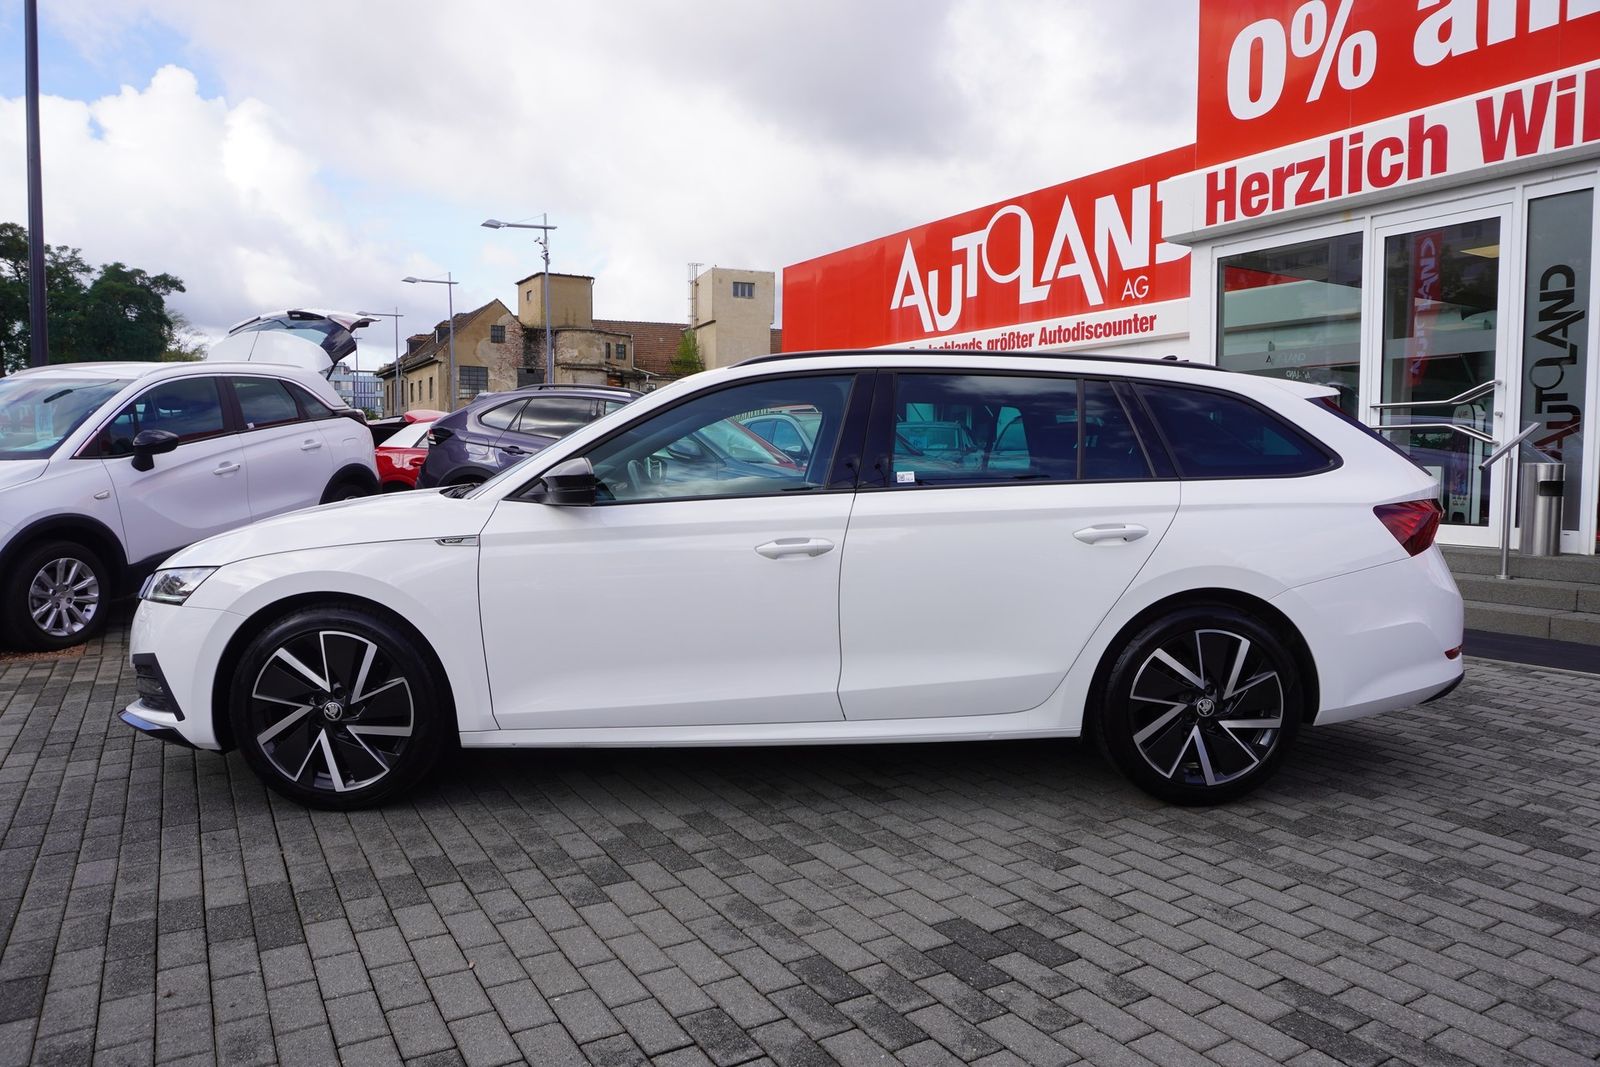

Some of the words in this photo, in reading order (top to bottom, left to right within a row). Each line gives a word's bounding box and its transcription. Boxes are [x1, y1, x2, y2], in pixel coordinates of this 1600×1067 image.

[1227, 0, 1378, 121] 0%
[1205, 114, 1448, 226] Herzlich
[987, 331, 1035, 351] größter
[1038, 313, 1158, 346] Autodiscounter
[1121, 275, 1149, 301] AG
[1529, 264, 1586, 462] AUTOLAND
